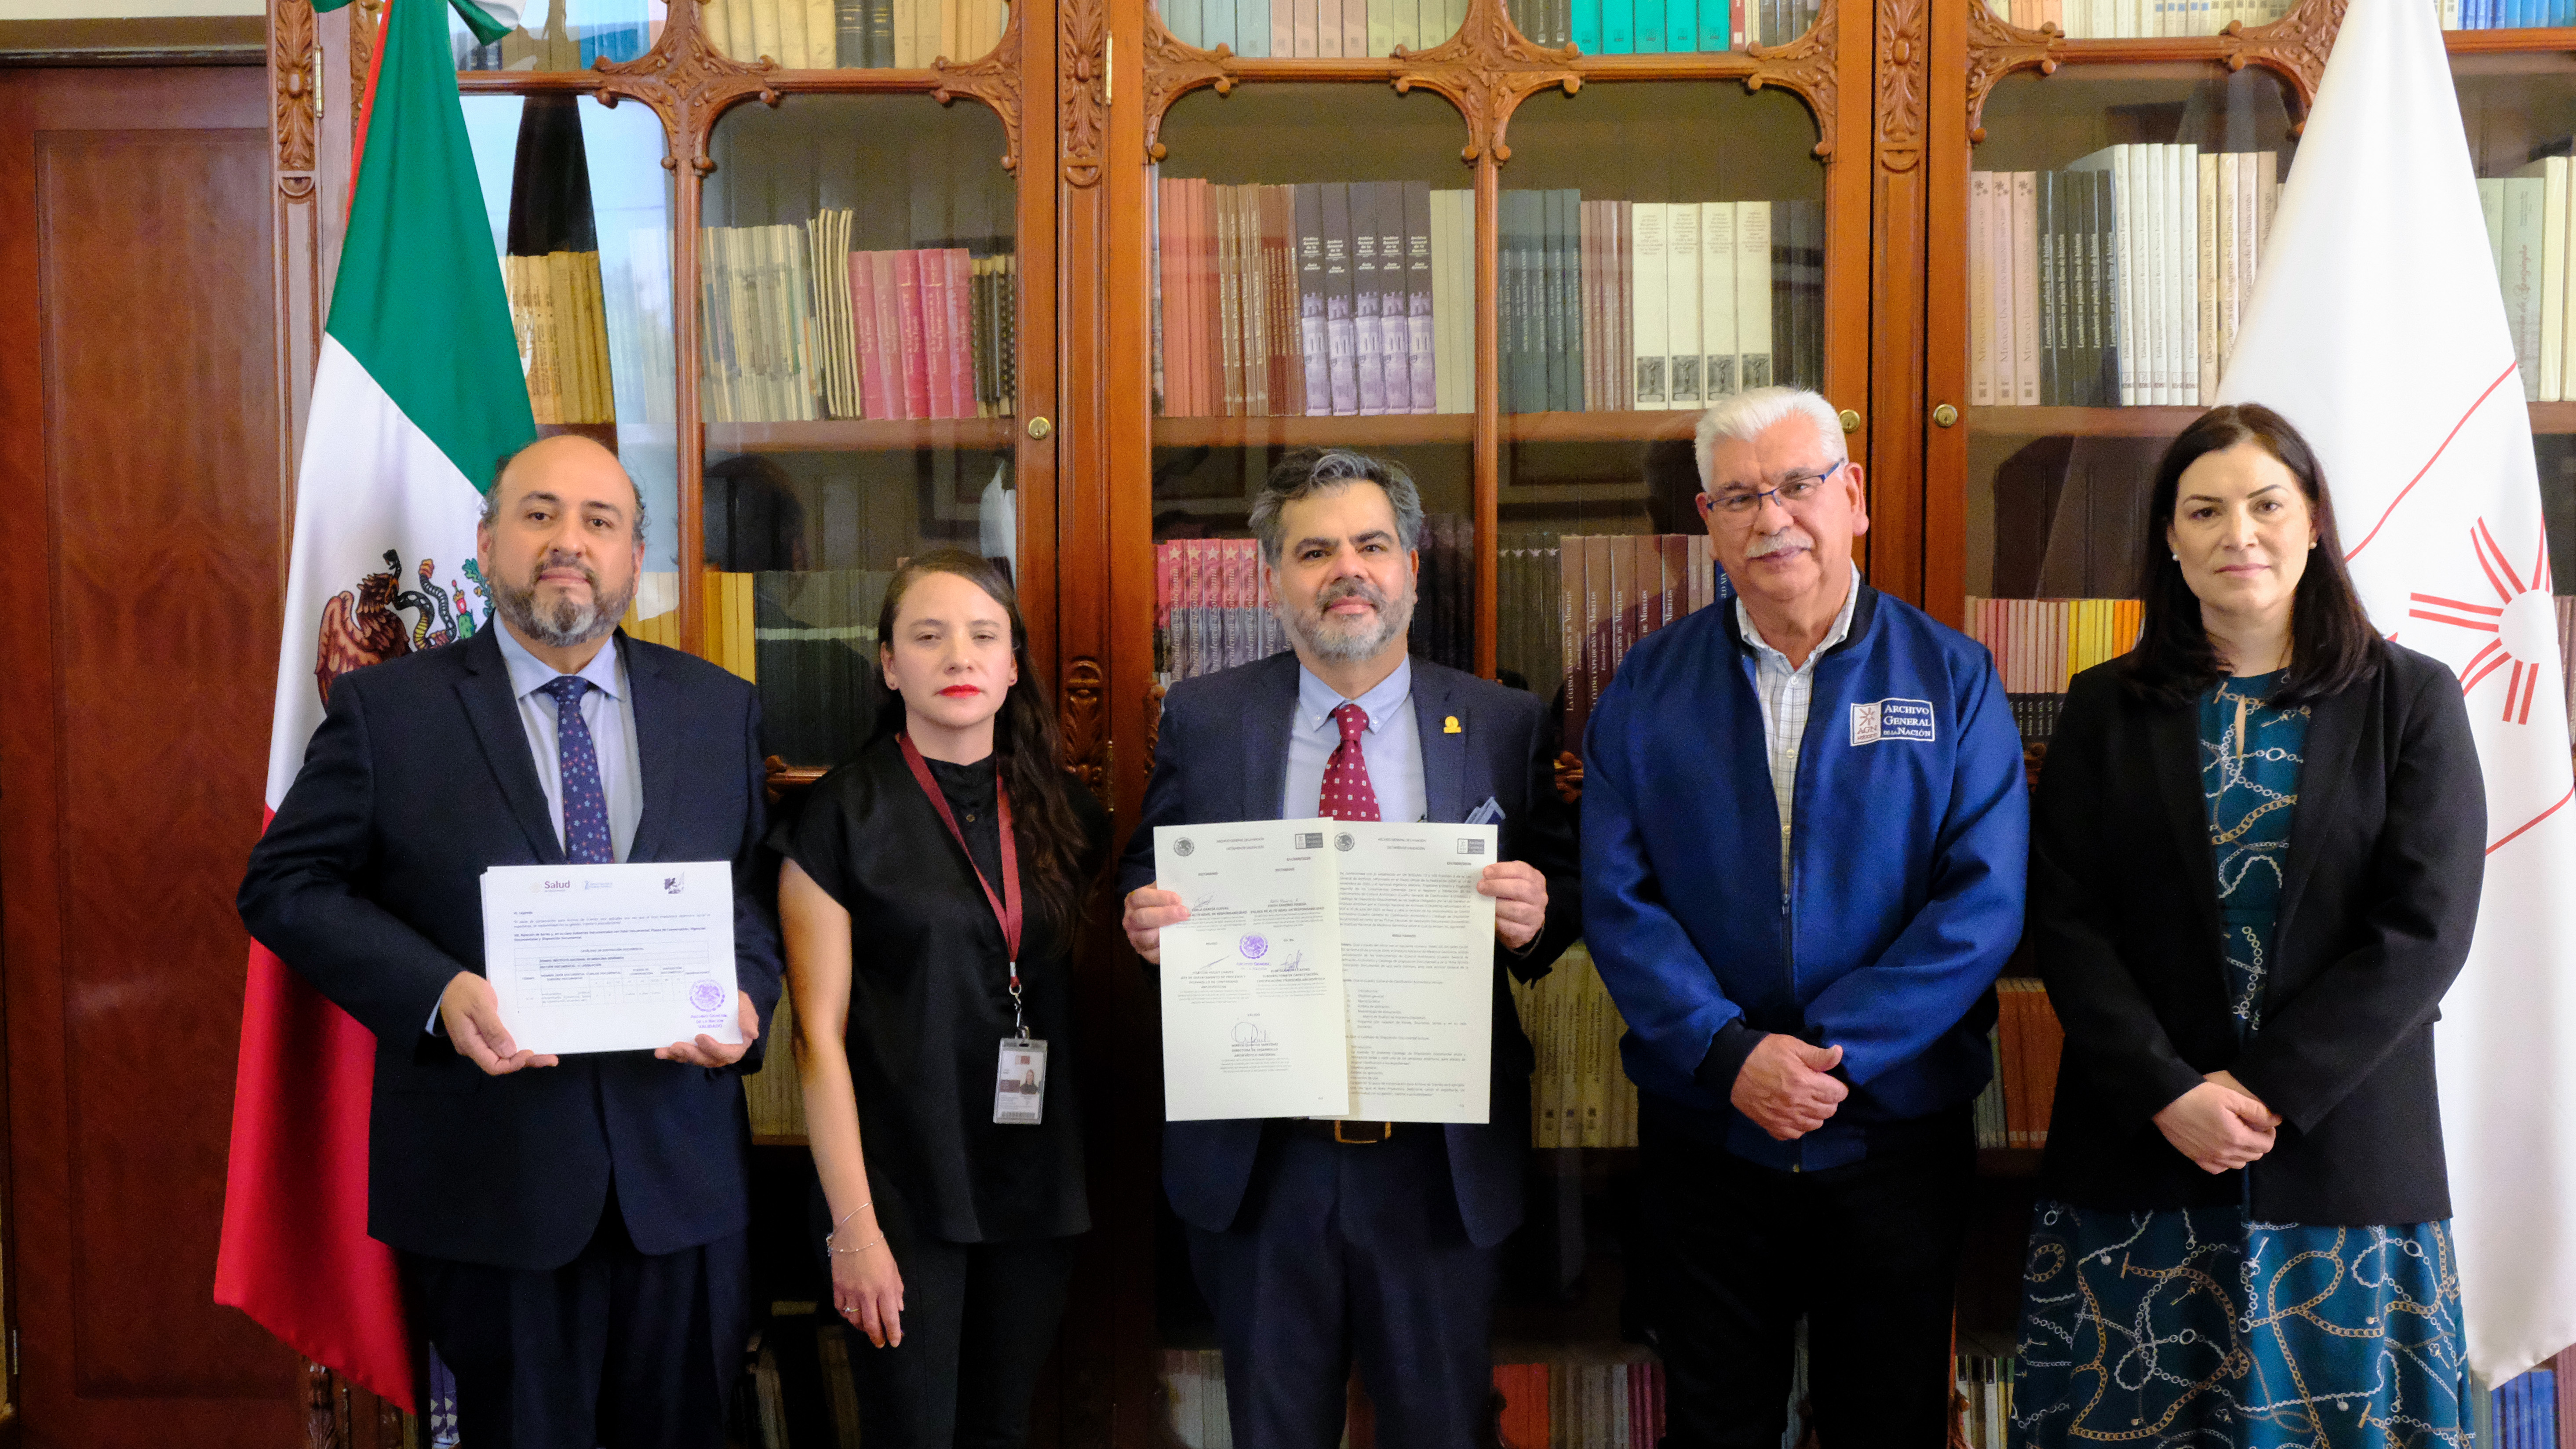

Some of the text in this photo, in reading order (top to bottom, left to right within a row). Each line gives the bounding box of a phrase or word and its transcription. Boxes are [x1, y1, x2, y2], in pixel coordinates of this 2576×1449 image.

[2204, 195, 2214, 248] Chilpancingo
[2204, 250, 2212, 259] de
[2205, 261, 2215, 298] Congreso
[2205, 313, 2213, 364] Documentos
[1643, 624, 1647, 633] DE
[1172, 623, 1181, 680] ndependencia
[1191, 623, 1200, 677] dependencia
[1228, 623, 1236, 667] pendencia
[1884, 704, 1929, 714] ARCHIVO
[1884, 716, 1931, 726] GENERAL
[1898, 727, 1931, 736] NACIÓN
[544, 880, 570, 889] Salud
